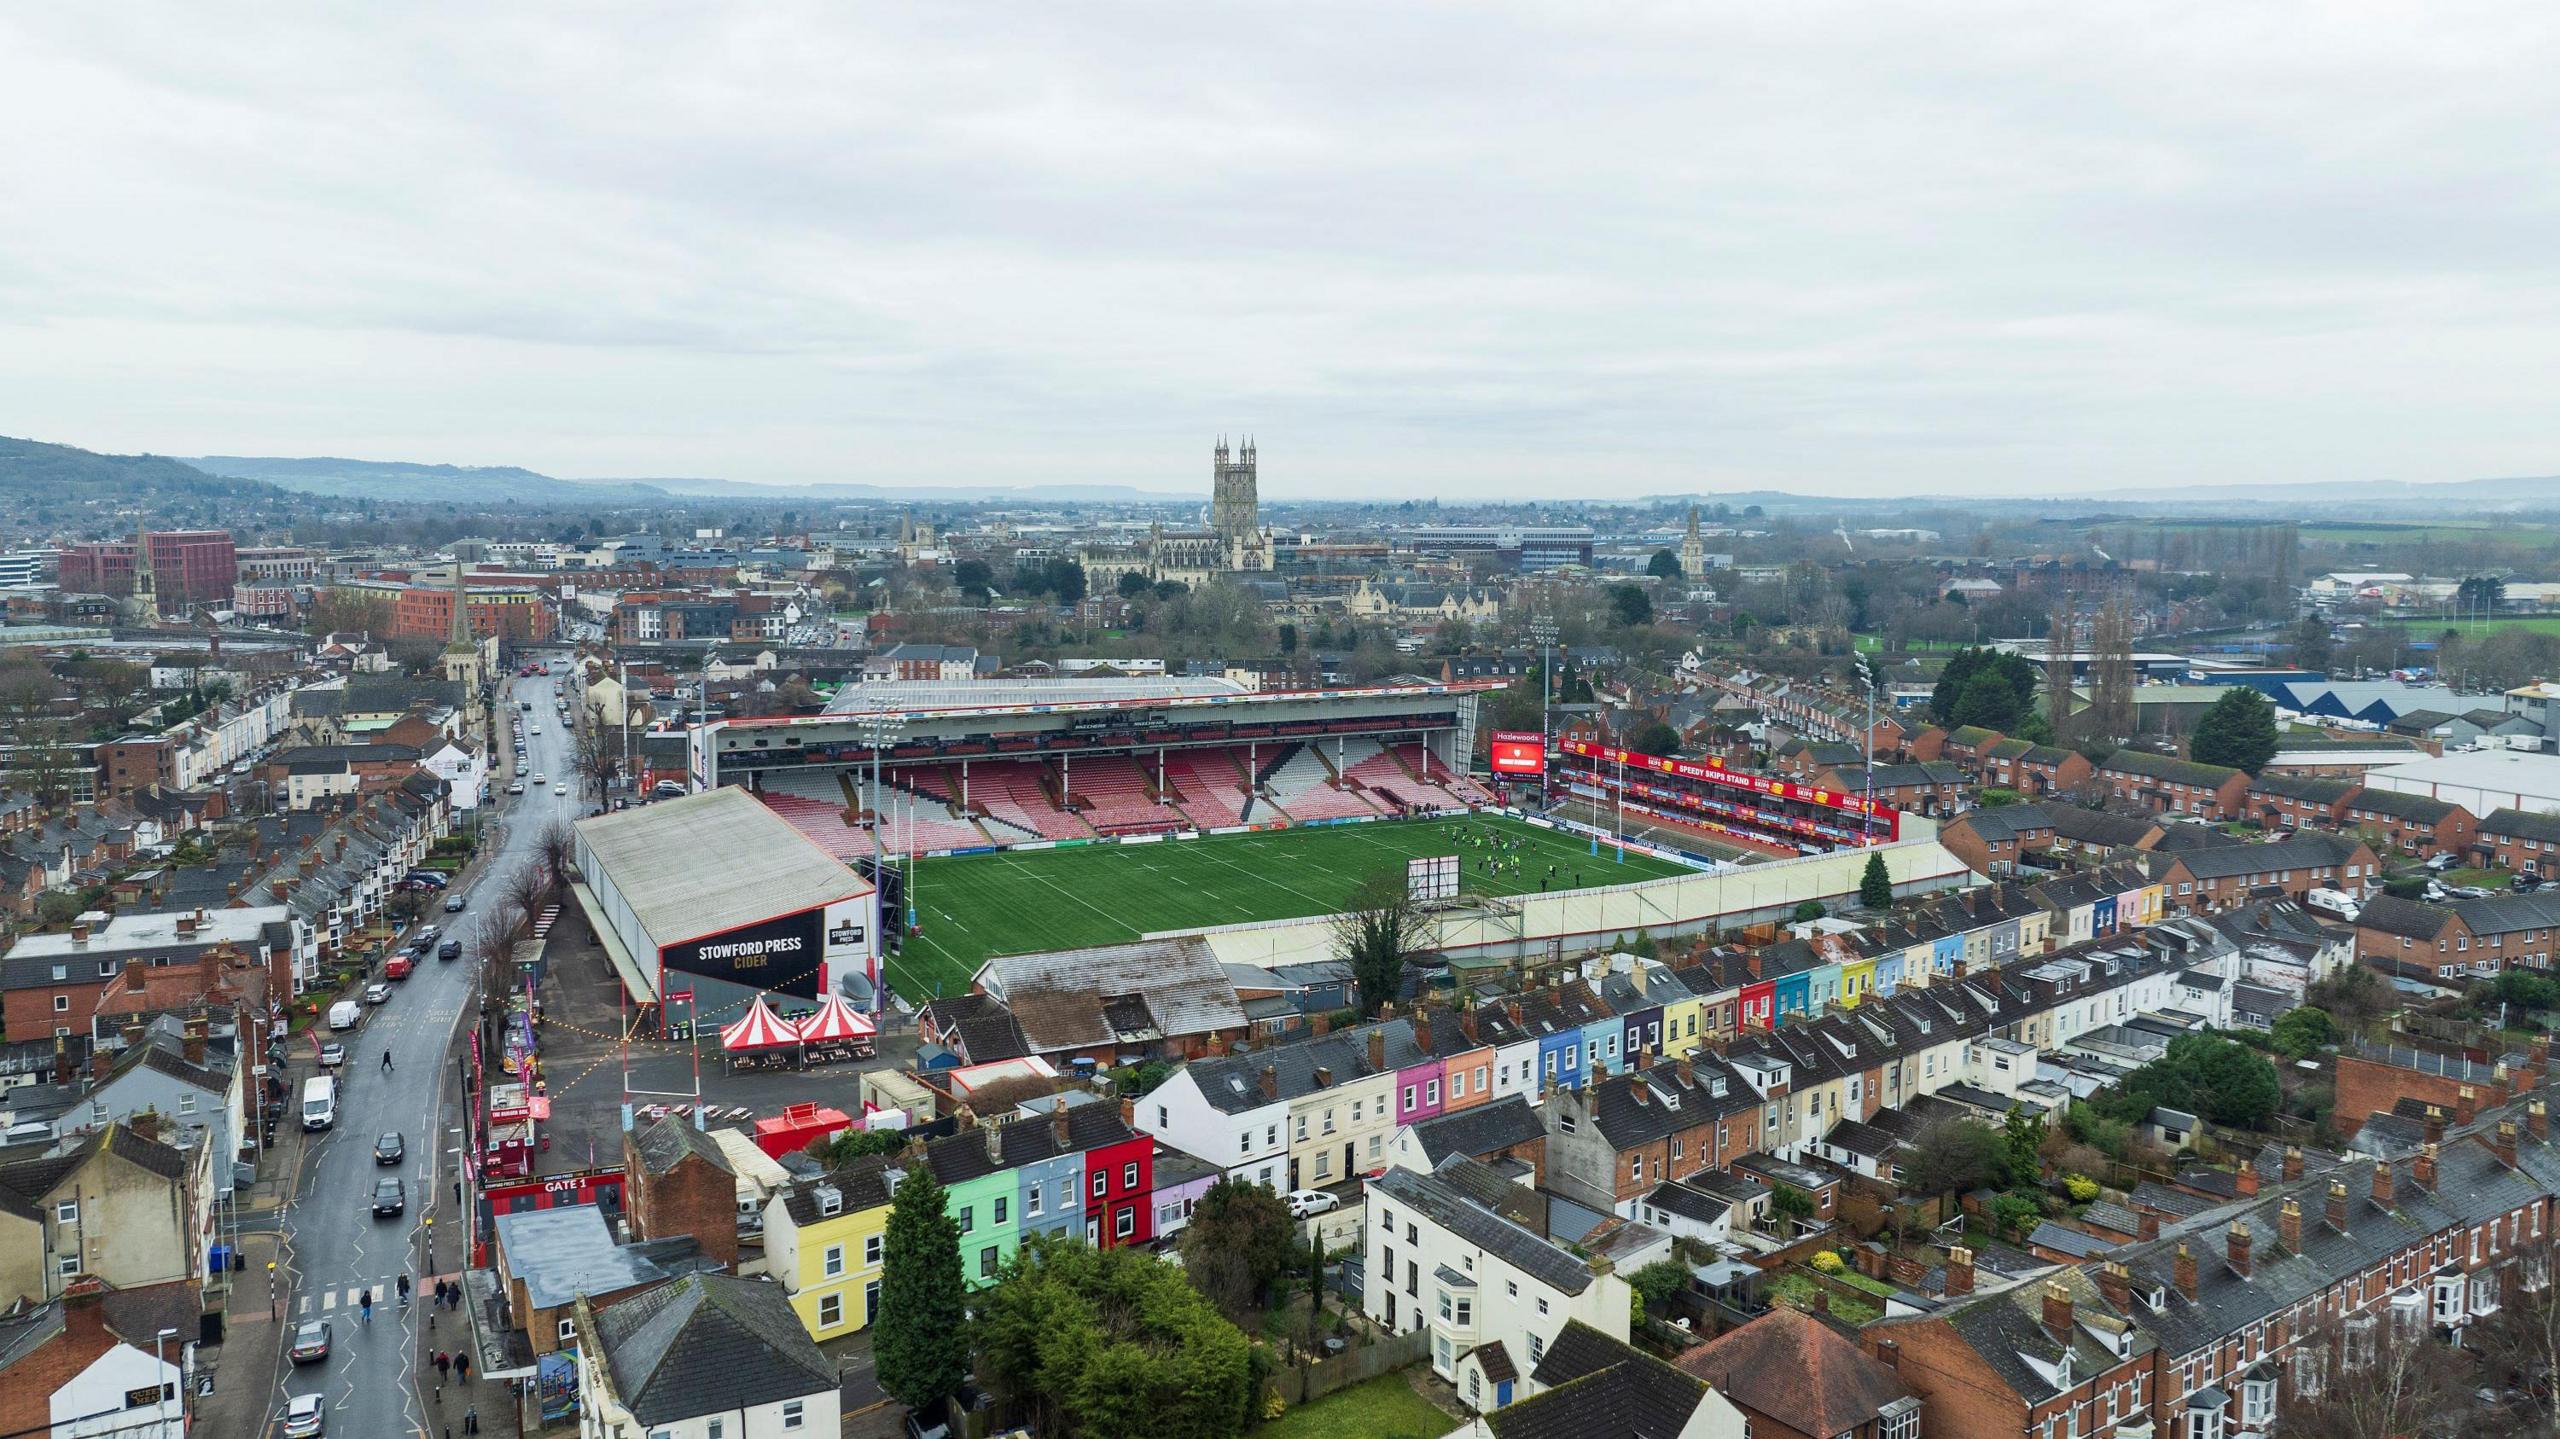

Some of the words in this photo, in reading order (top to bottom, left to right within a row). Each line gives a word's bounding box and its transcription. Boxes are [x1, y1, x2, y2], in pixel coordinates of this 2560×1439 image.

[1497, 732, 1539, 741] Hazlewoods
[1679, 764, 1704, 777] SPEEDY
[1705, 768, 1725, 781] SKIPS
[1726, 774, 1749, 786] STAND
[832, 929, 862, 938] STOWFORD
[699, 940, 762, 960] STOWFORD
[765, 937, 802, 953] PRESS
[734, 954, 768, 969] CIDER
[545, 1179, 578, 1192] GATE
[580, 1178, 587, 1188] 1
